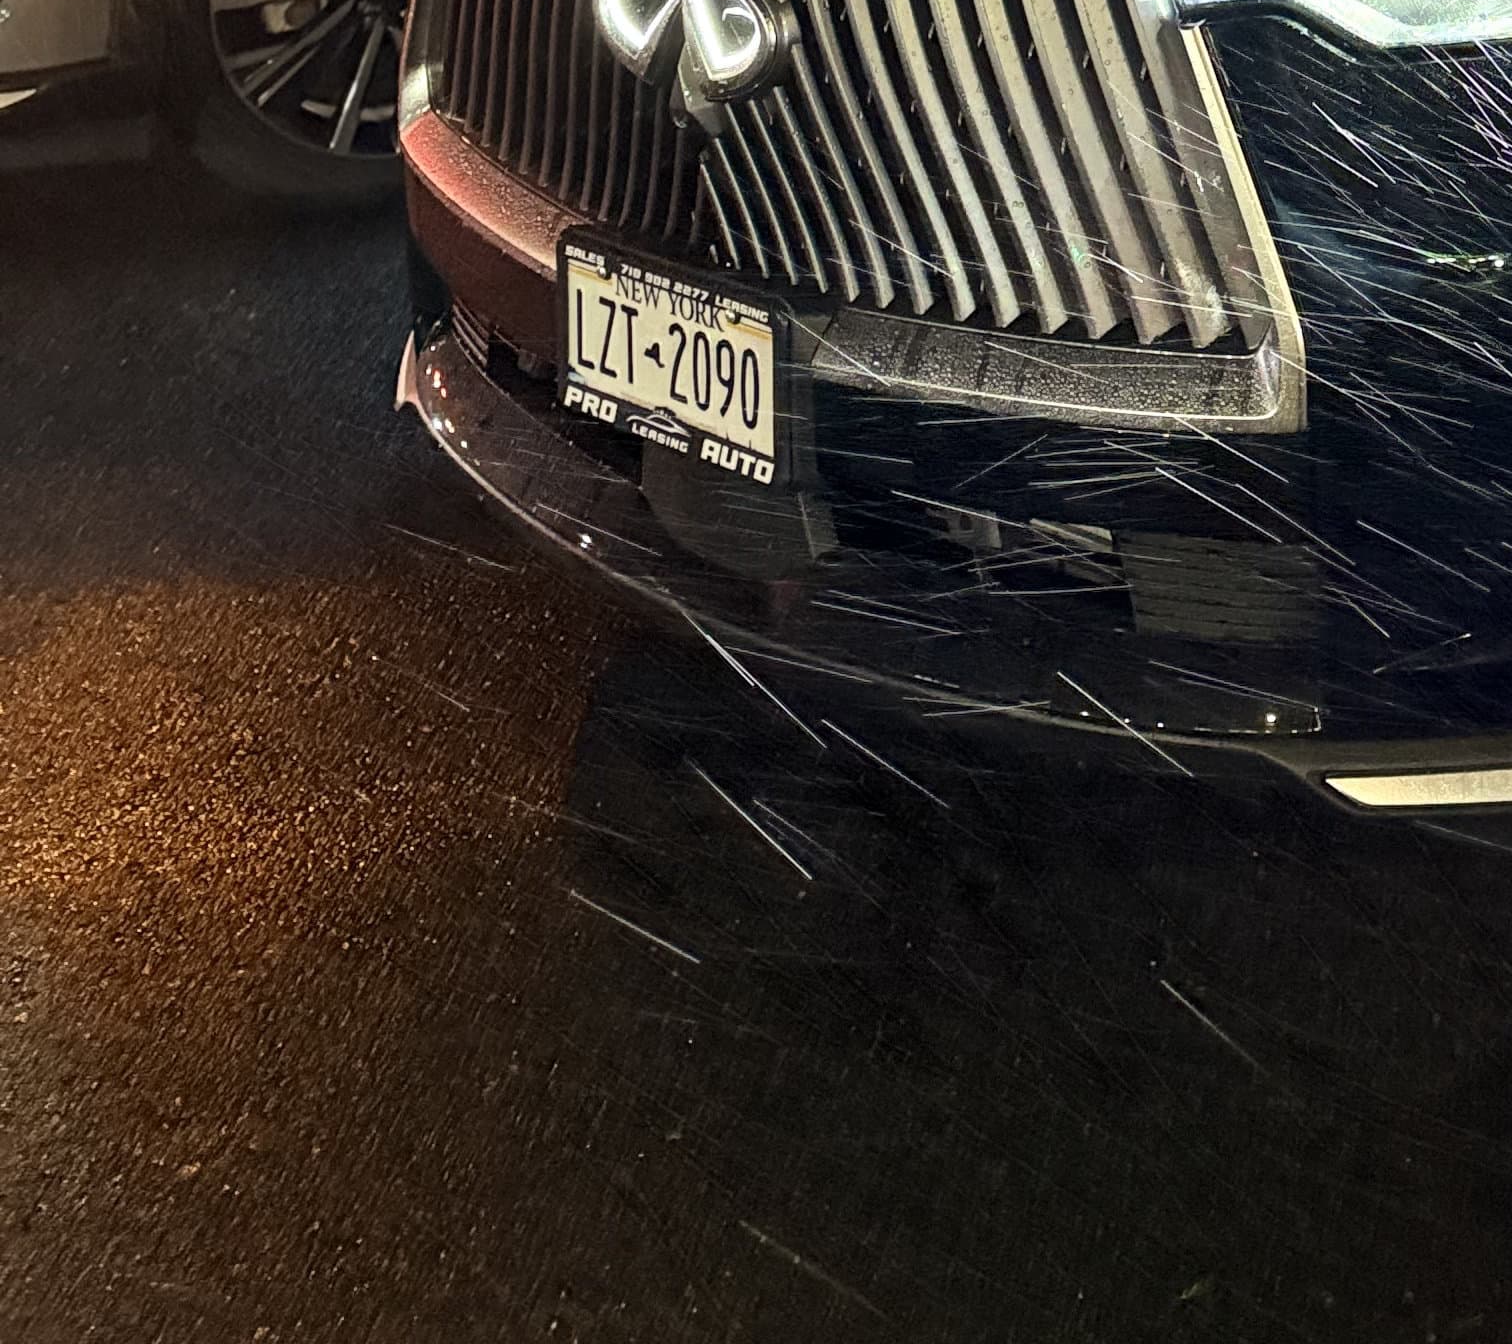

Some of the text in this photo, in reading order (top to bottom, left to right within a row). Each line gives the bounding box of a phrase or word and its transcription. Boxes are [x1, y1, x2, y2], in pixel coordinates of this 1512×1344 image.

[564, 244, 605, 266] SALES
[646, 271, 670, 289] 902
[673, 282, 710, 302] 2277
[715, 294, 769, 323] LEASING
[615, 275, 726, 333] NEW YORK
[576, 287, 760, 431] LZT 2090
[563, 385, 775, 485] PRO AUTO
[631, 421, 689, 454] LEASING
